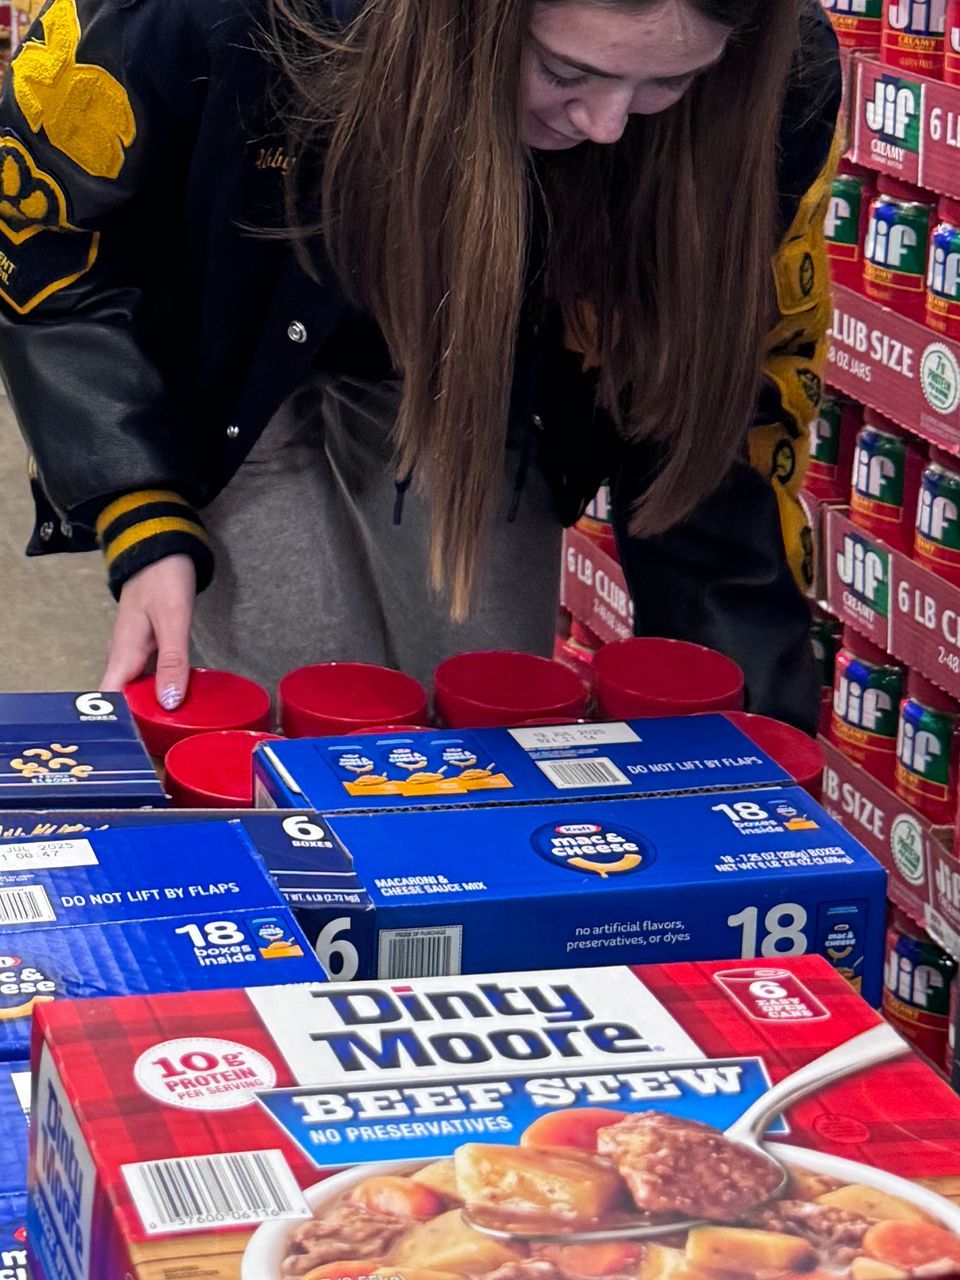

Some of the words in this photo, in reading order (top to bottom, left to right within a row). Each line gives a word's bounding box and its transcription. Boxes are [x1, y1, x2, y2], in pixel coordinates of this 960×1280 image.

[898, 35, 936, 48] CREAMY
[866, 81, 916, 139] Jif
[929, 107, 943, 141] 6
[870, 138, 904, 162] CREAMY
[864, 217, 917, 267] Jif
[869, 329, 915, 379] SIZE
[850, 358, 872, 383] JARS
[851, 444, 896, 498] Jif
[916, 489, 959, 540] Jif
[836, 535, 884, 602] Jif
[595, 570, 627, 617] CLUB
[897, 580, 909, 613] 6
[914, 588, 937, 629] LB
[76, 692, 114, 717] 6
[834, 677, 892, 731] Jif
[897, 719, 942, 773] Jif
[627, 765, 646, 775] DO
[648, 763, 673, 774] NOT
[677, 761, 702, 772] LIFT
[705, 759, 722, 769] BY
[723, 756, 764, 767] FLAPS
[711, 801, 769, 820] 18
[841, 781, 885, 841] SIZE
[282, 815, 325, 841] 6
[551, 834, 602, 847] mac
[605, 832, 626, 844] &
[6, 846, 30, 854] JUL
[39, 842, 75, 851] 2025
[291, 839, 333, 848] BOXES
[807, 846, 846, 857] BOXES
[374, 875, 436, 888] MACARONI
[437, 875, 448, 884] &
[380, 885, 425, 897] CHEESE
[426, 883, 461, 894] SAUCE
[462, 881, 487, 891] MIX
[61, 894, 85, 908] DO
[89, 892, 123, 906] NOT
[128, 888, 159, 902] LIFT
[164, 886, 185, 899] BY
[189, 882, 240, 898] FLAPS
[174, 920, 245, 948] 18
[575, 926, 591, 935] no
[592, 921, 641, 934] artificial
[643, 920, 685, 933] flavors,
[727, 901, 808, 959] 18
[193, 944, 252, 958] boxes
[315, 917, 359, 982] 6
[566, 934, 646, 952] preservatives,
[648, 934, 661, 943] or
[663, 931, 690, 944] dyes
[199, 951, 257, 967] inside
[19, 967, 44, 982] &
[885, 951, 944, 1006] Jif
[748, 981, 788, 999] 6
[755, 997, 802, 1008] EASY
[309, 982, 596, 1026] Dinty
[761, 1003, 807, 1013] OPEN
[767, 1009, 813, 1018] CANS
[308, 1021, 654, 1072] Moore
[163, 1067, 257, 1094] PROTEIN
[176, 1087, 206, 1101] PER
[208, 1078, 265, 1097] SERVING
[292, 1080, 514, 1124] BEEF
[530, 1065, 743, 1110] STEW
[309, 1129, 339, 1146] NO
[346, 1114, 514, 1144] PRESERVATIVES
[46, 1078, 83, 1220] Dinty
